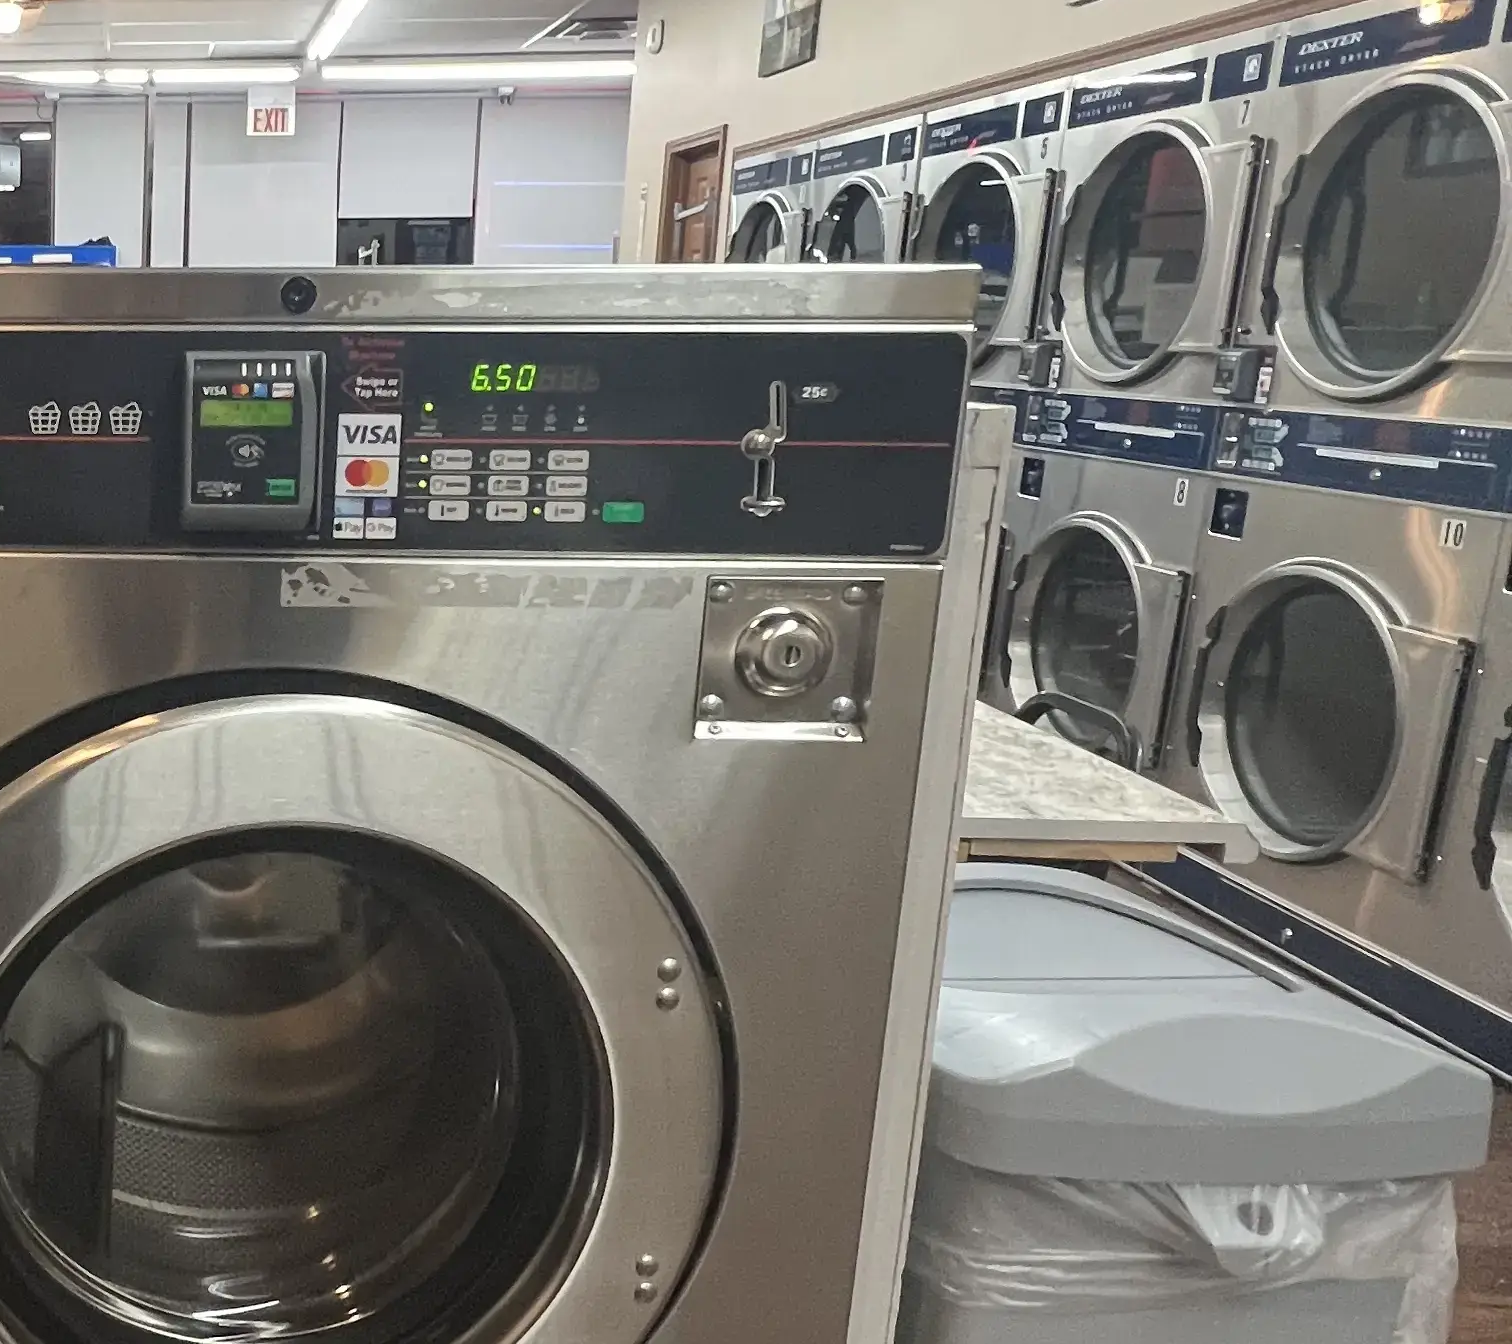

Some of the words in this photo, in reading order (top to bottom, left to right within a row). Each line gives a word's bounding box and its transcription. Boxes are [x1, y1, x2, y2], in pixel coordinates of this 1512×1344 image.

[1298, 31, 1364, 56] DEXTER
[253, 108, 289, 132] EXIT
[1241, 99, 1251, 125] 7
[470, 363, 538, 393] 6.50
[202, 386, 228, 396] VISA
[354, 387, 373, 399] Tap
[801, 386, 828, 400] 25¢
[342, 424, 398, 445] VISA
[1177, 480, 1186, 504] 8
[1444, 521, 1465, 547] 10
